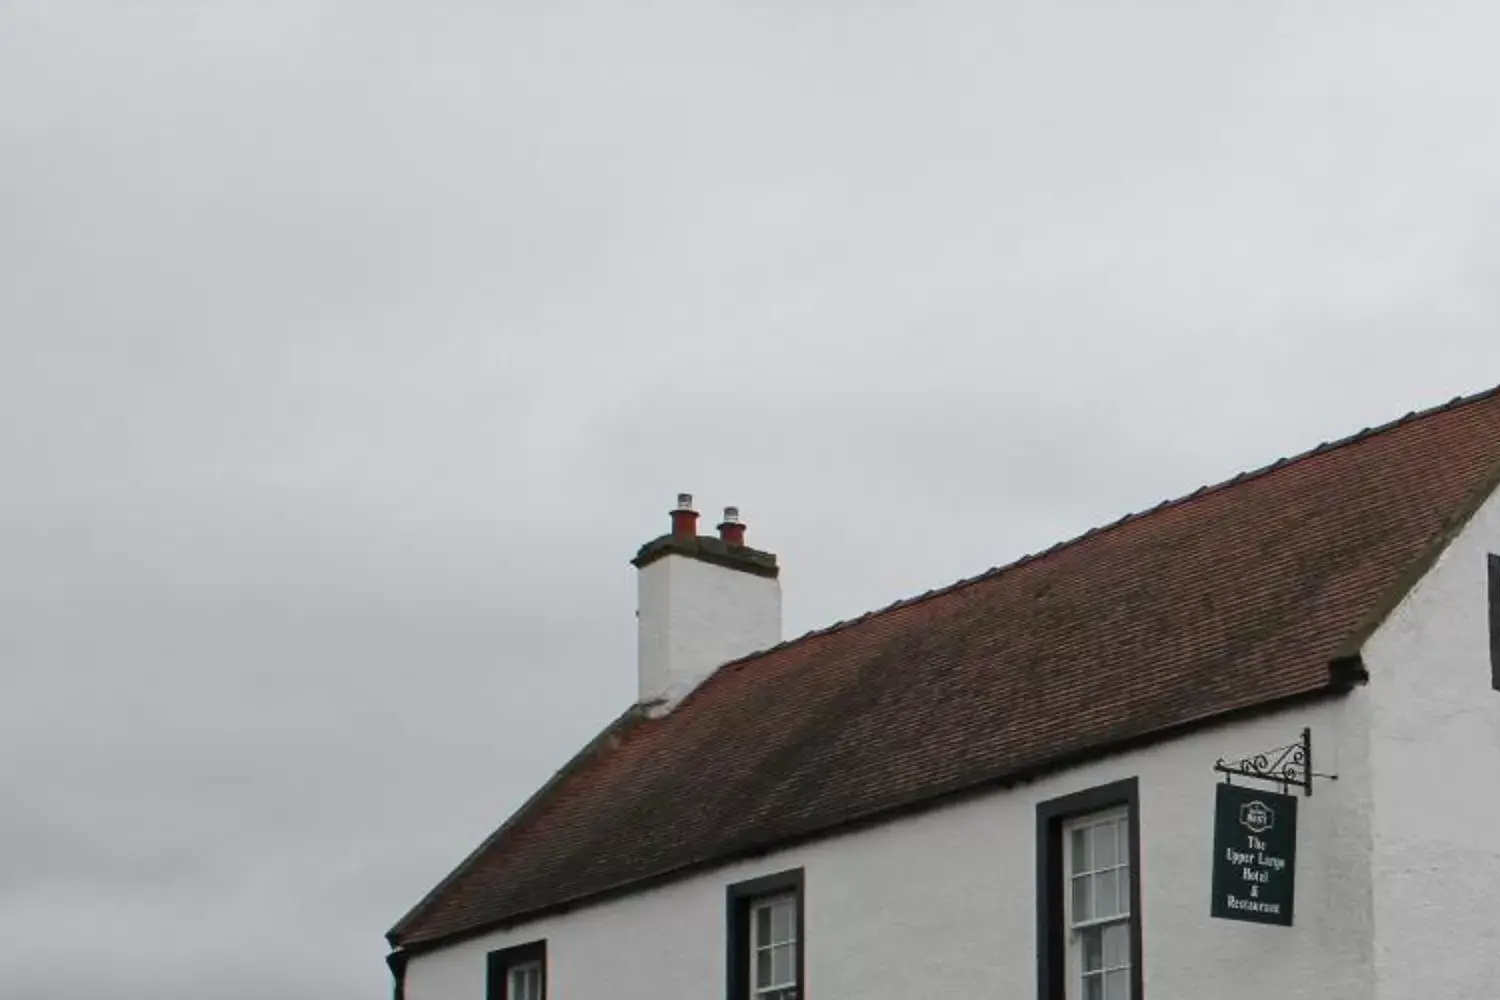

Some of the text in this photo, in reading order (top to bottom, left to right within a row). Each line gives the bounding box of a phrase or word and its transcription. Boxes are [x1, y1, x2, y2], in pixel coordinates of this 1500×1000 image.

[1247, 835, 1266, 850] The
[1226, 847, 1256, 865] Upper
[1242, 866, 1269, 884] Hotel
[1250, 884, 1259, 898] &
[1227, 894, 1281, 914] Restaurant
